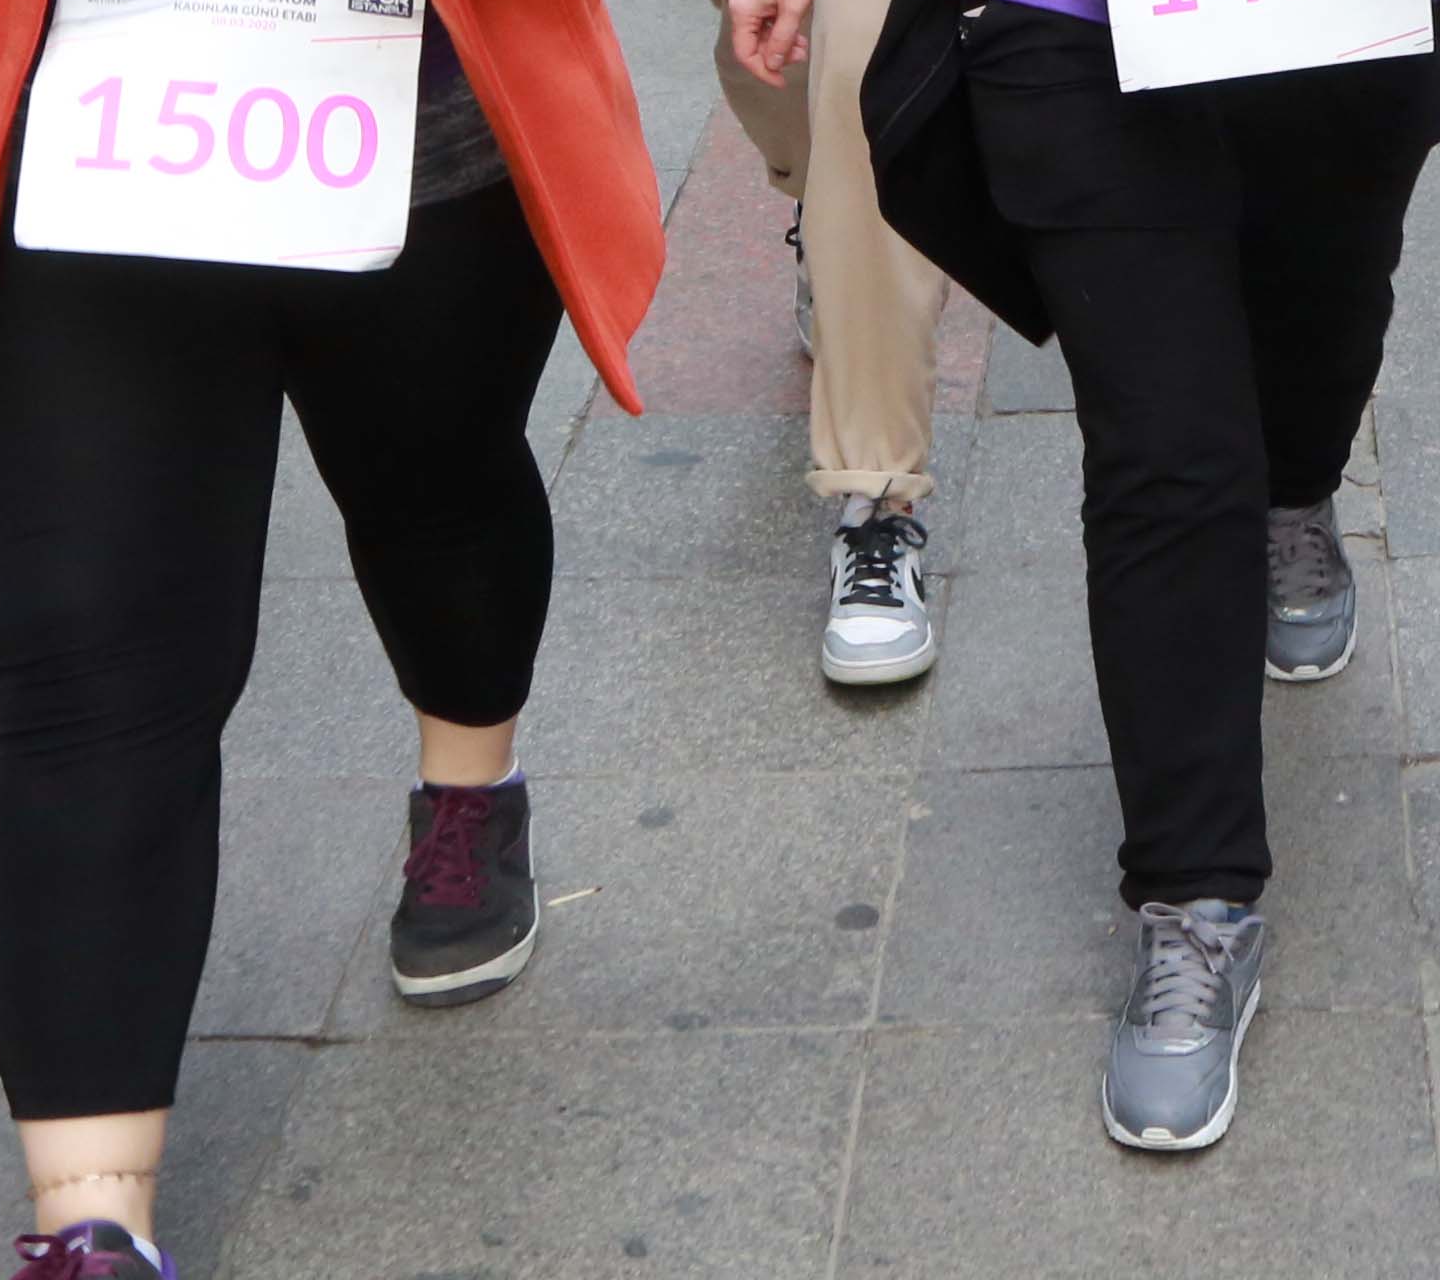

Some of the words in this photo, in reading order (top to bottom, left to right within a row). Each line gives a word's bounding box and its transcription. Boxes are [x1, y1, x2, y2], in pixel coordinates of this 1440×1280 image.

[172, 0, 240, 16] KADINLAR
[241, 3, 280, 19] GÜNÜ
[280, 7, 318, 23] ETABI
[73, 75, 379, 190] 1500
